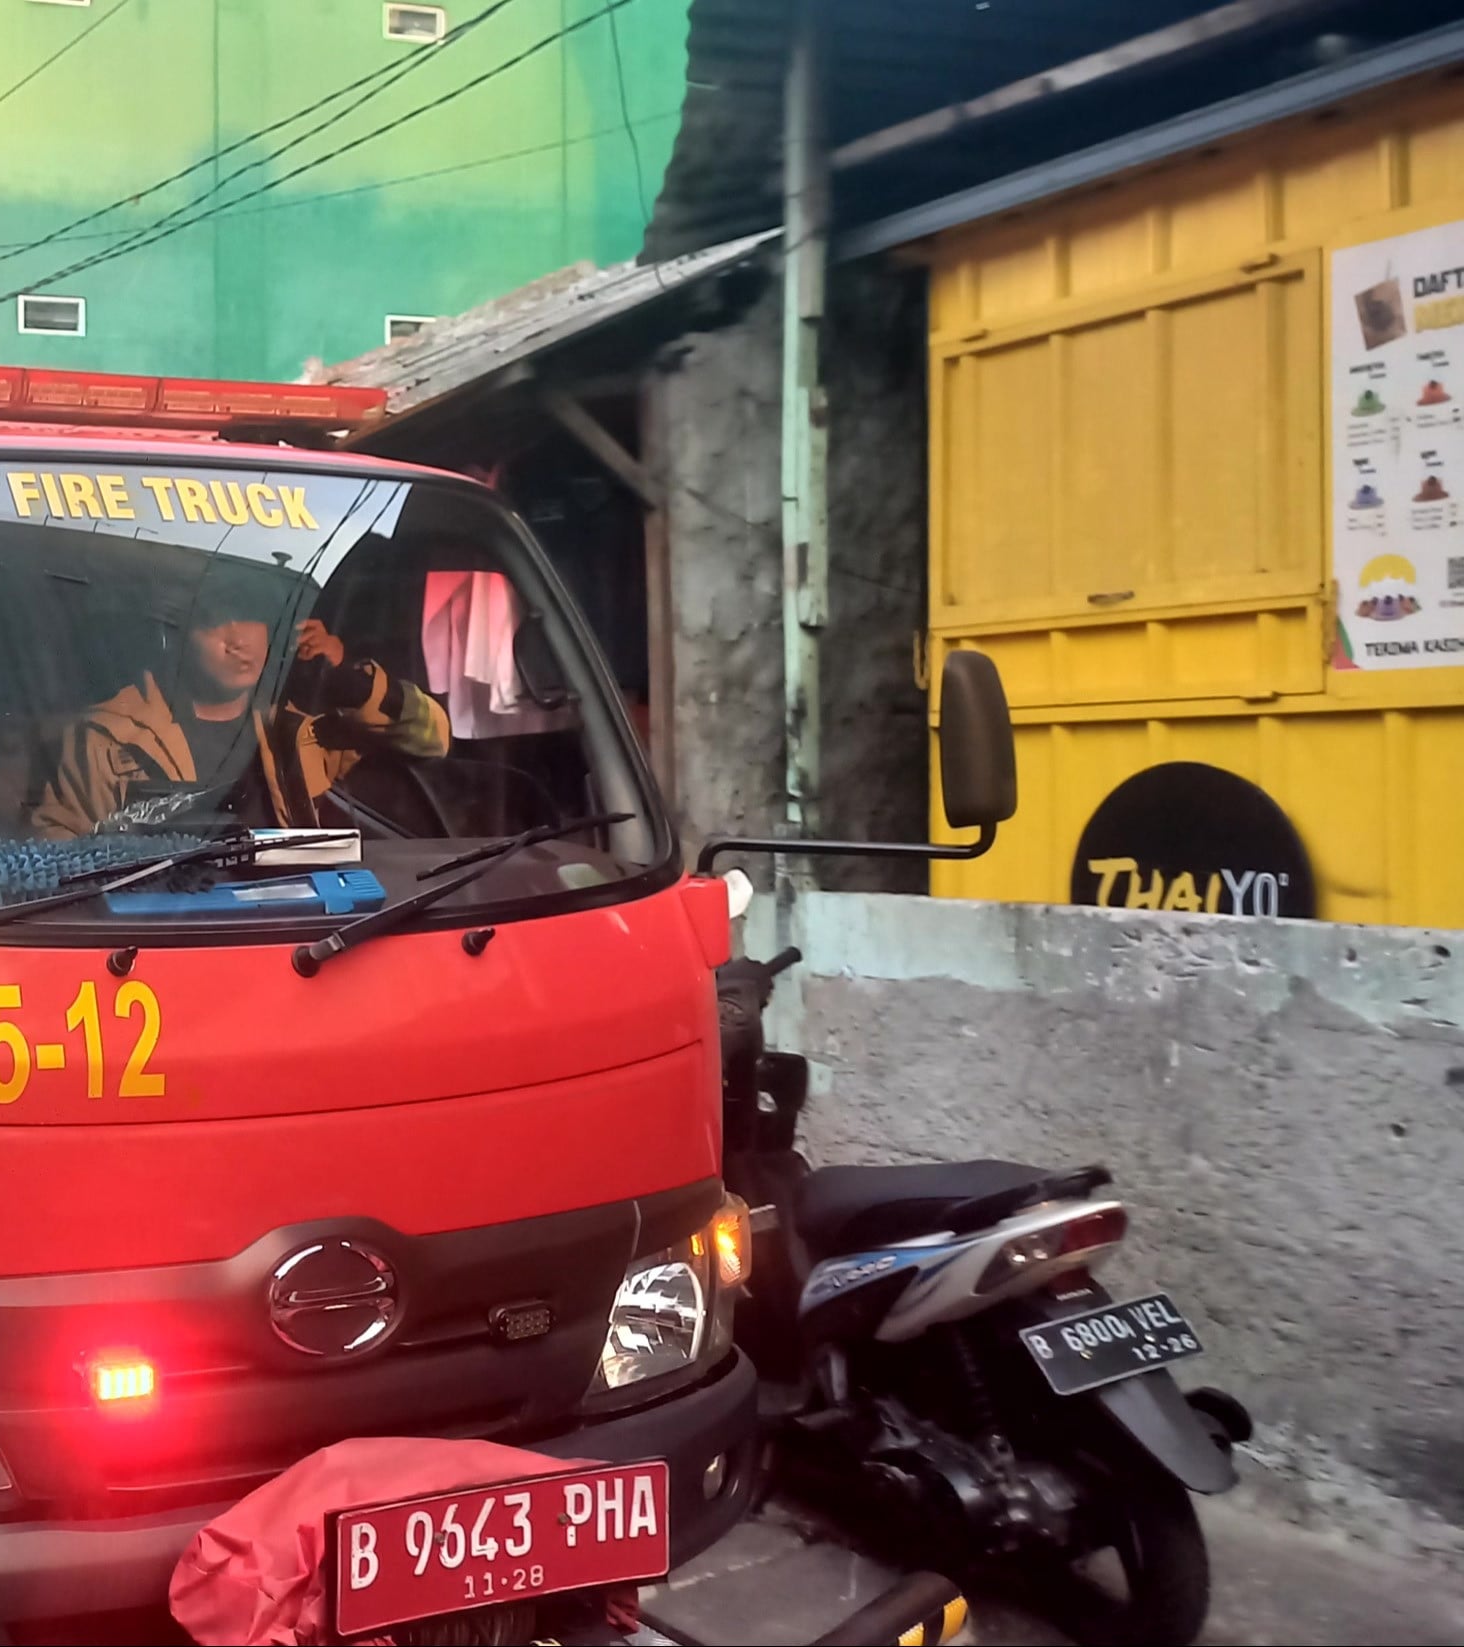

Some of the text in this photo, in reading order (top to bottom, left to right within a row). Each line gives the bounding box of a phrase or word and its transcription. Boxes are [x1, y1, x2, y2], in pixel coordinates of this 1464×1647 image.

[7, 472, 320, 530] FIRE TRUCK
[1028, 1300, 1184, 1359] B 6800 VEL
[351, 1475, 658, 1590] B 9643 PHA
